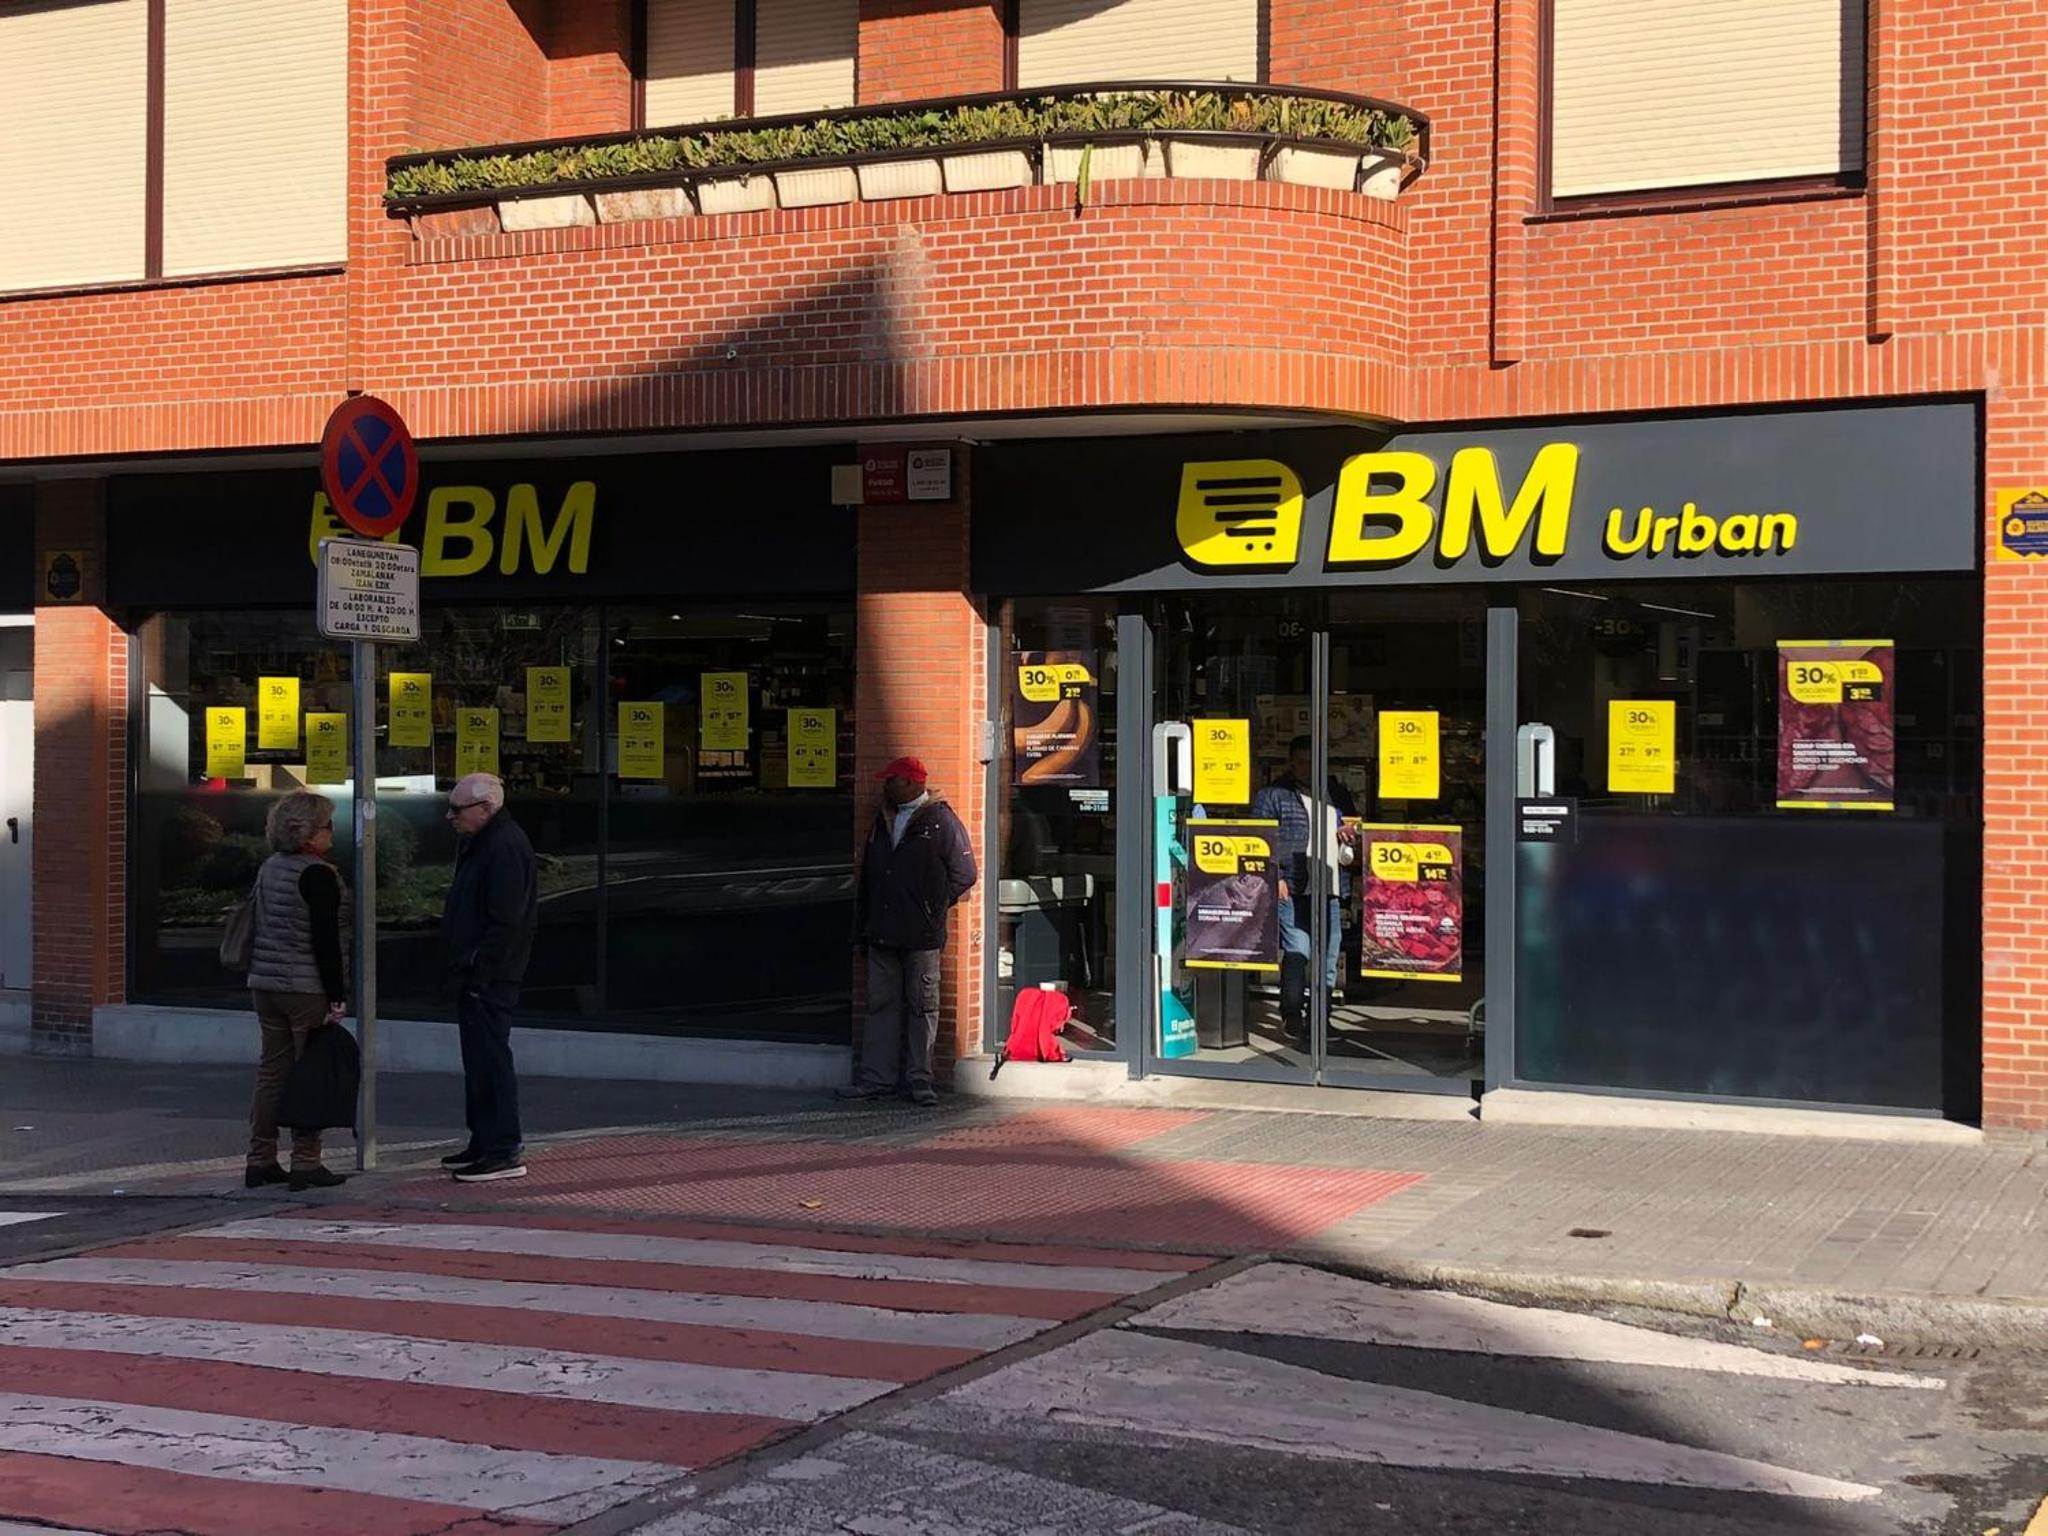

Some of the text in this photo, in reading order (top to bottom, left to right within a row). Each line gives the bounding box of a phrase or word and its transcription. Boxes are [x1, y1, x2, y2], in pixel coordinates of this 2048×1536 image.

[1328, 443, 1798, 562] BM Urban
[420, 481, 597, 577] BM
[347, 549, 400, 561] LANEGUNETAN
[350, 569, 395, 580] ZAMALANAK
[349, 593, 396, 604] LABORABLES
[329, 601, 339, 610] DE
[356, 613, 390, 623] EXCEPTO
[334, 622, 360, 631] CARGA
[371, 624, 411, 634] DESCARGA
[1025, 671, 1056, 686] 30%
[1795, 667, 1837, 684] 30%
[1629, 712, 1655, 724] 30%
[1397, 722, 1422, 733] 30%
[1210, 730, 1233, 741] 30%
[1200, 841, 1233, 857] 30%
[1378, 848, 1414, 864] 30%
